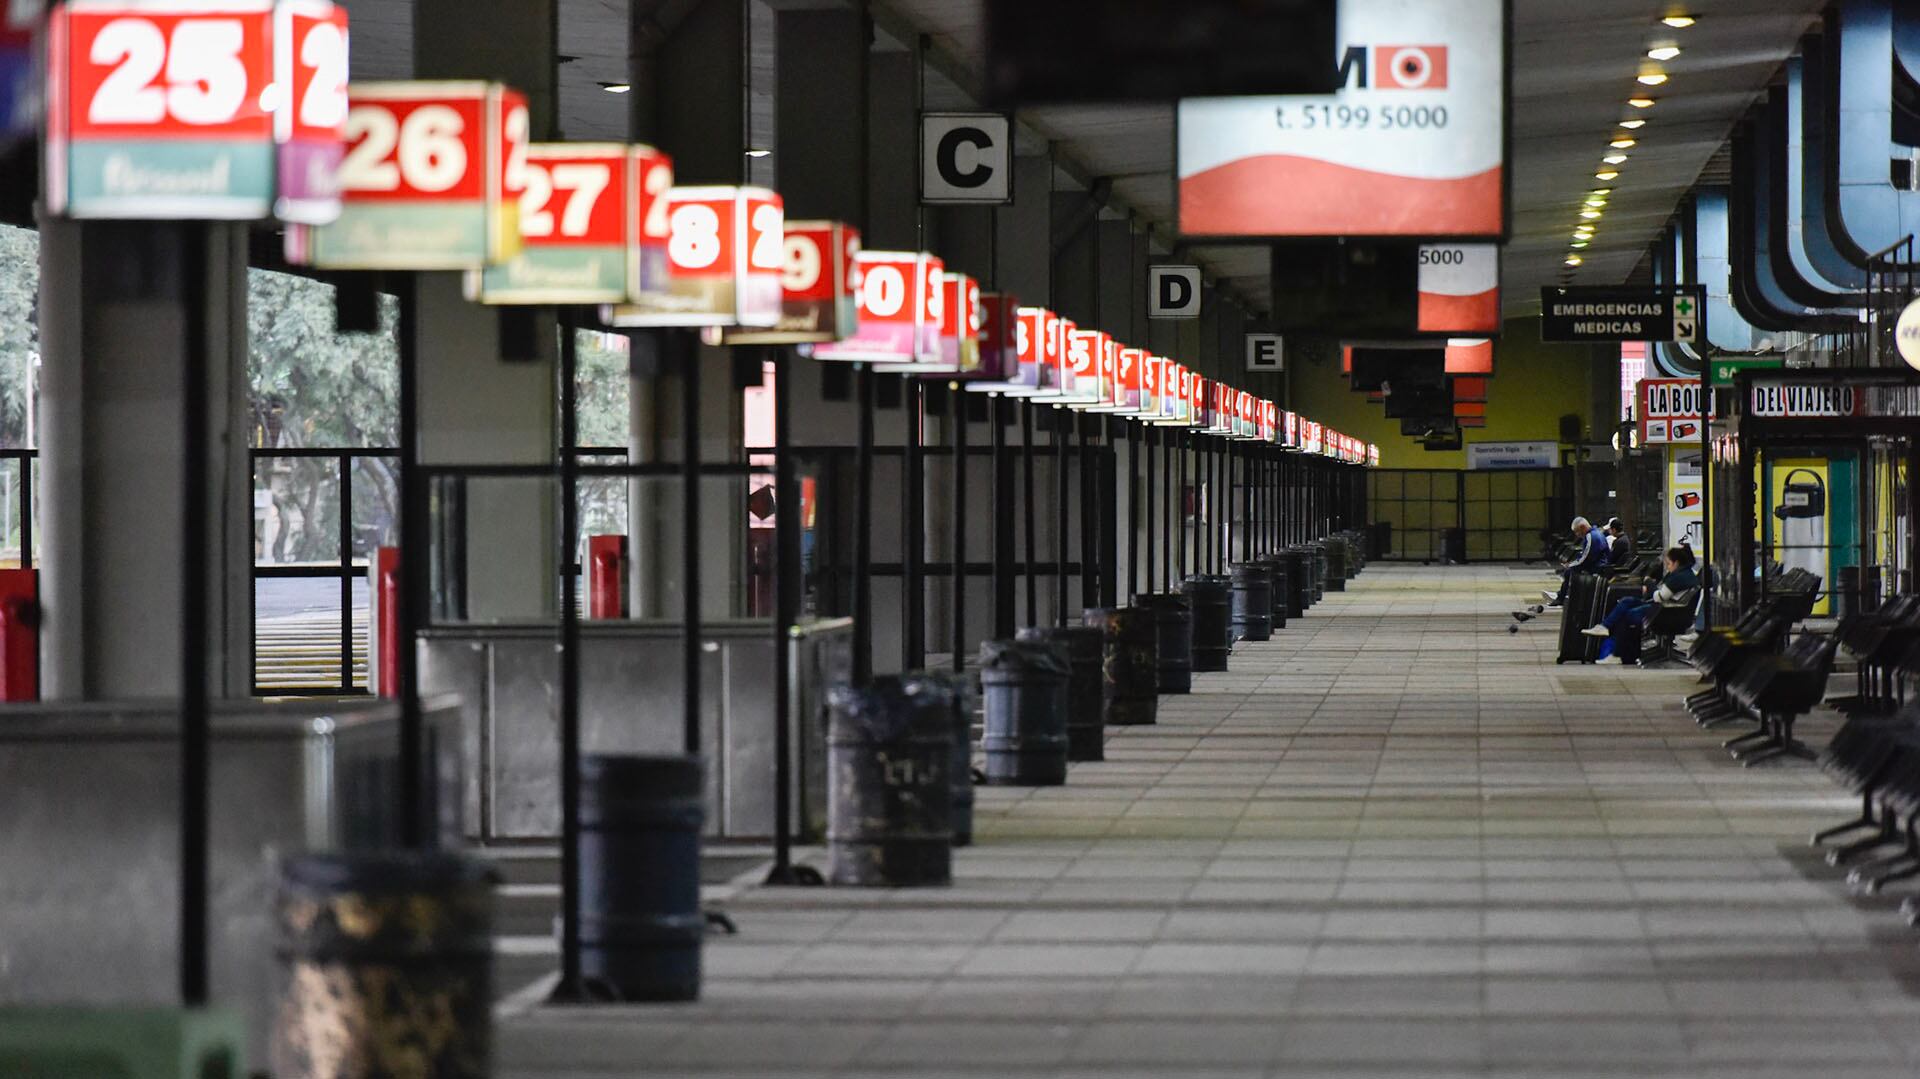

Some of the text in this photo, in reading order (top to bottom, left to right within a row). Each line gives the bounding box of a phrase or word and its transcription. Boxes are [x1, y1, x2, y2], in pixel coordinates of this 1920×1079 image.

[88, 18, 247, 124] 25
[1302, 104, 1370, 128] 5199
[1379, 104, 1448, 128] 5000
[341, 104, 467, 192] 26
[937, 127, 994, 188] C
[519, 163, 610, 237] 27
[668, 203, 721, 268] 8
[782, 235, 822, 291] 9
[1419, 250, 1464, 265] 5000
[1159, 275, 1192, 309] D
[1553, 304, 1663, 316] EMERGENCIAS
[1574, 322, 1642, 334] MEDICAS
[1254, 340, 1276, 365] E
[1756, 387, 1783, 412] DEL
[1788, 387, 1852, 412] VIAJERO
